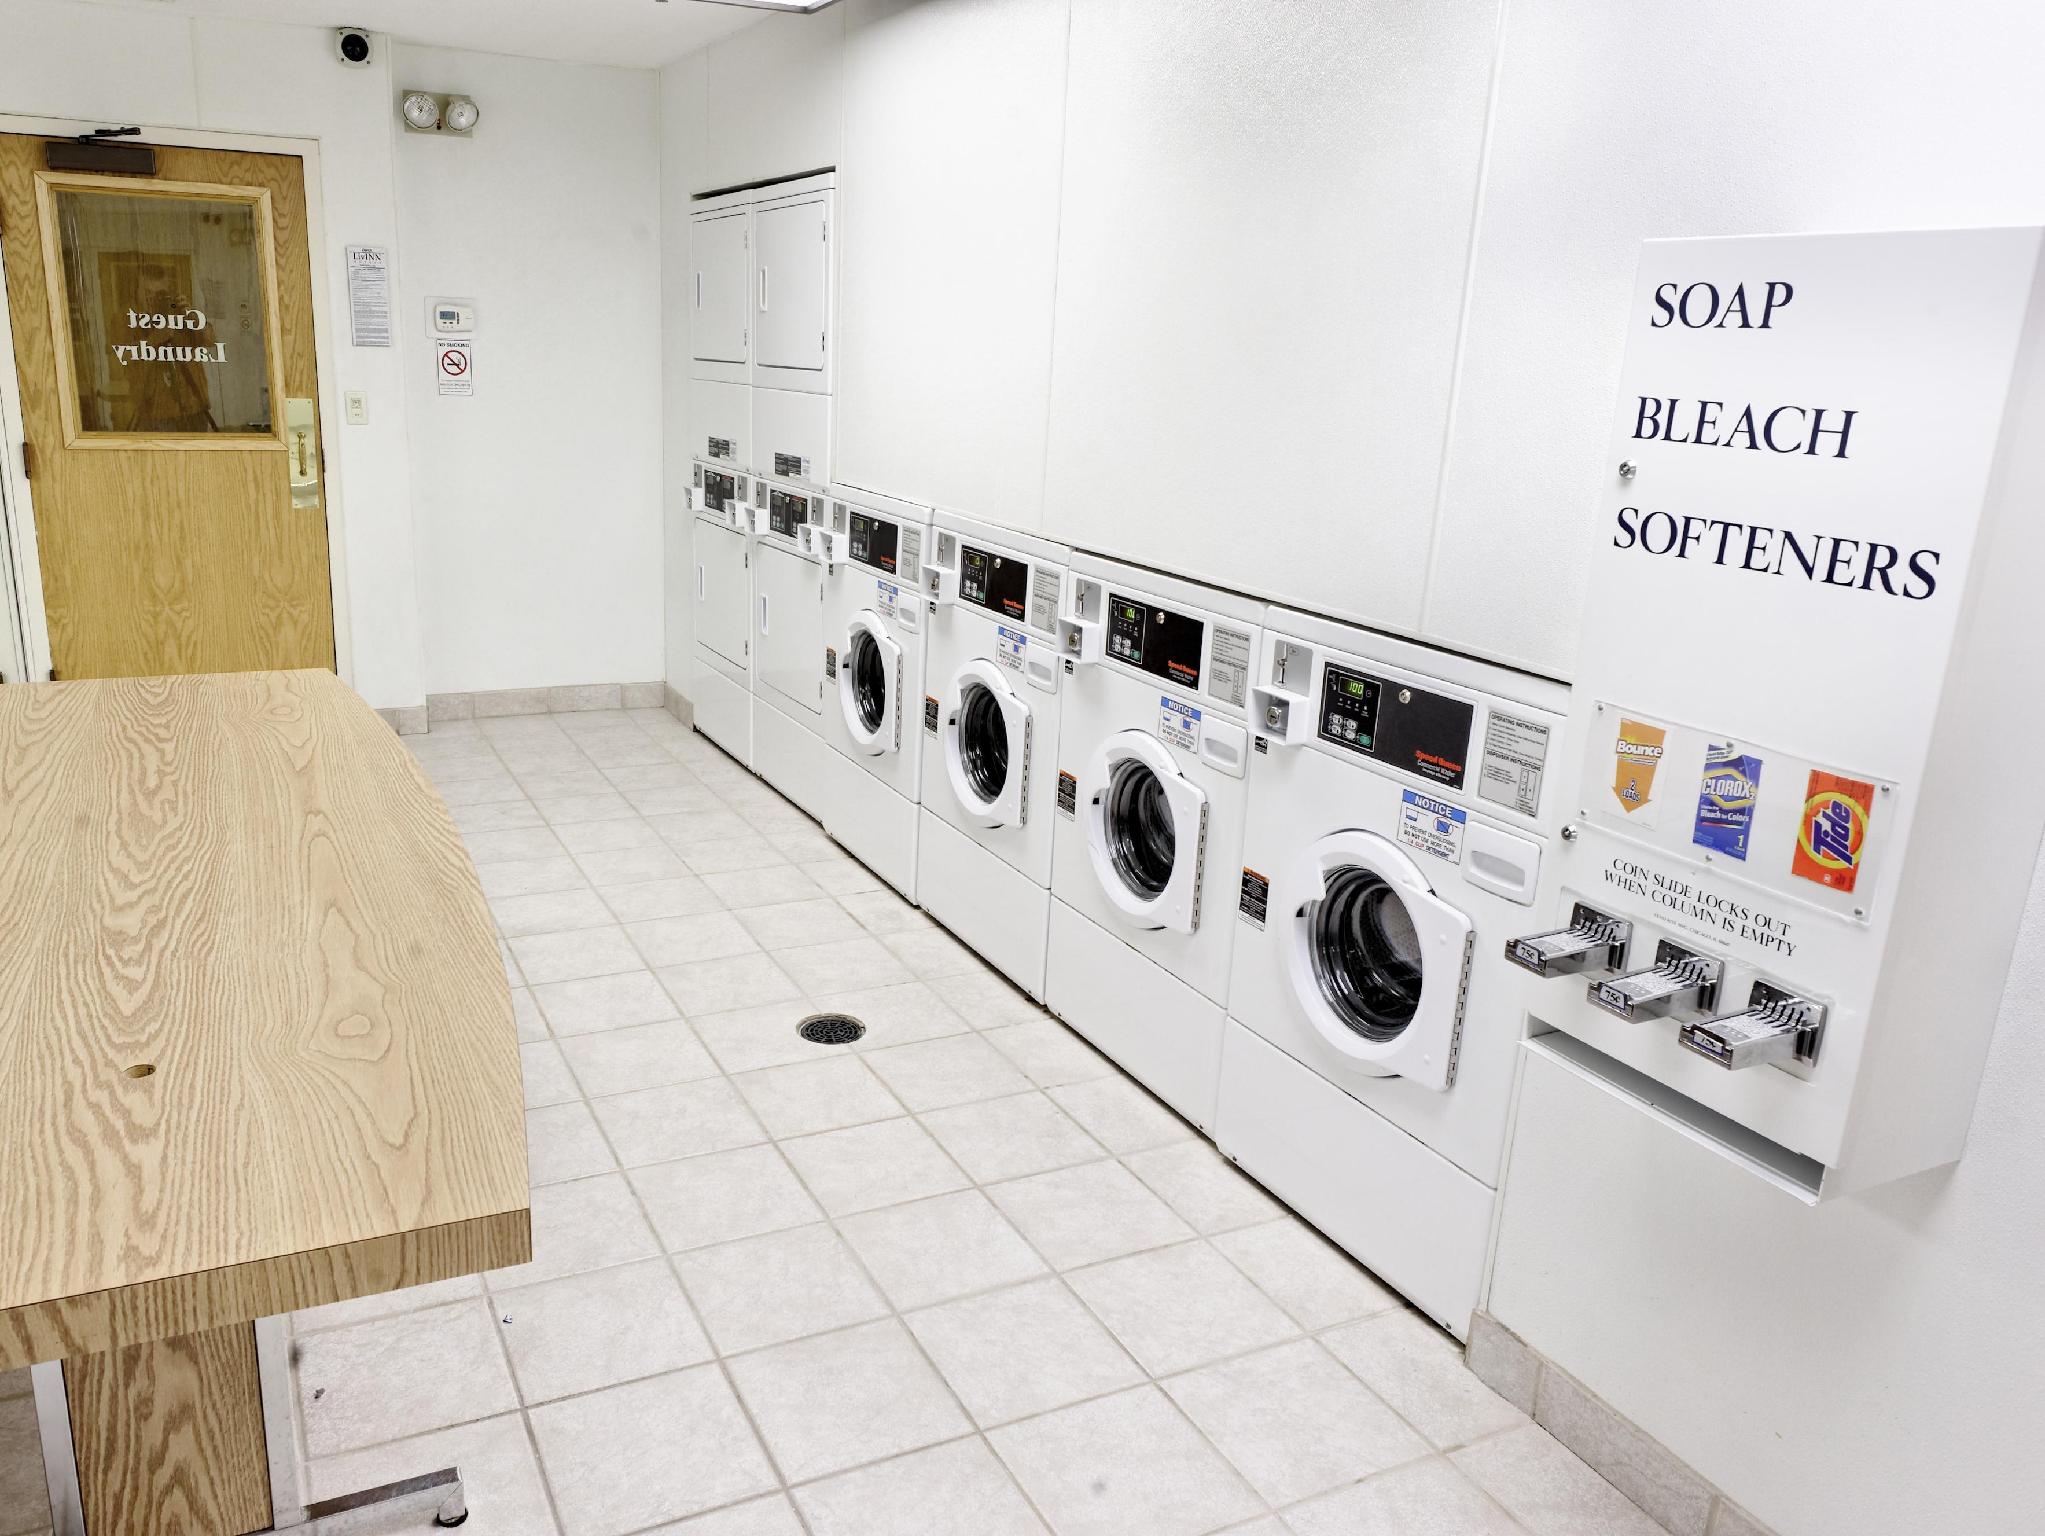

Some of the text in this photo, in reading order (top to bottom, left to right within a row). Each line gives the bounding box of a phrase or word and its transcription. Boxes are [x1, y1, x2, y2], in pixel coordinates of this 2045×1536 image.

[1651, 281, 1794, 329] SOAP
[1631, 396, 1859, 459] BLEACH
[1613, 507, 1941, 600] SOFTENERS
[1616, 738, 1663, 758] Bounce
[1414, 795, 1453, 818] NOTICE
[1630, 779, 1637, 791] 2
[1700, 809, 1721, 819] Bleach
[1728, 813, 1750, 822] Colors
[1812, 799, 1853, 869] Tide
[1605, 869, 1648, 896] WHEN
[1651, 890, 1717, 924] COLUMN
[1722, 917, 1736, 932] IS
[1740, 924, 1797, 957] EMPTY
[1613, 858, 1650, 881] COIN
[1653, 873, 1692, 899] SLIDE
[1697, 890, 1750, 921] LOCKS
[1754, 913, 1791, 936] OUT
